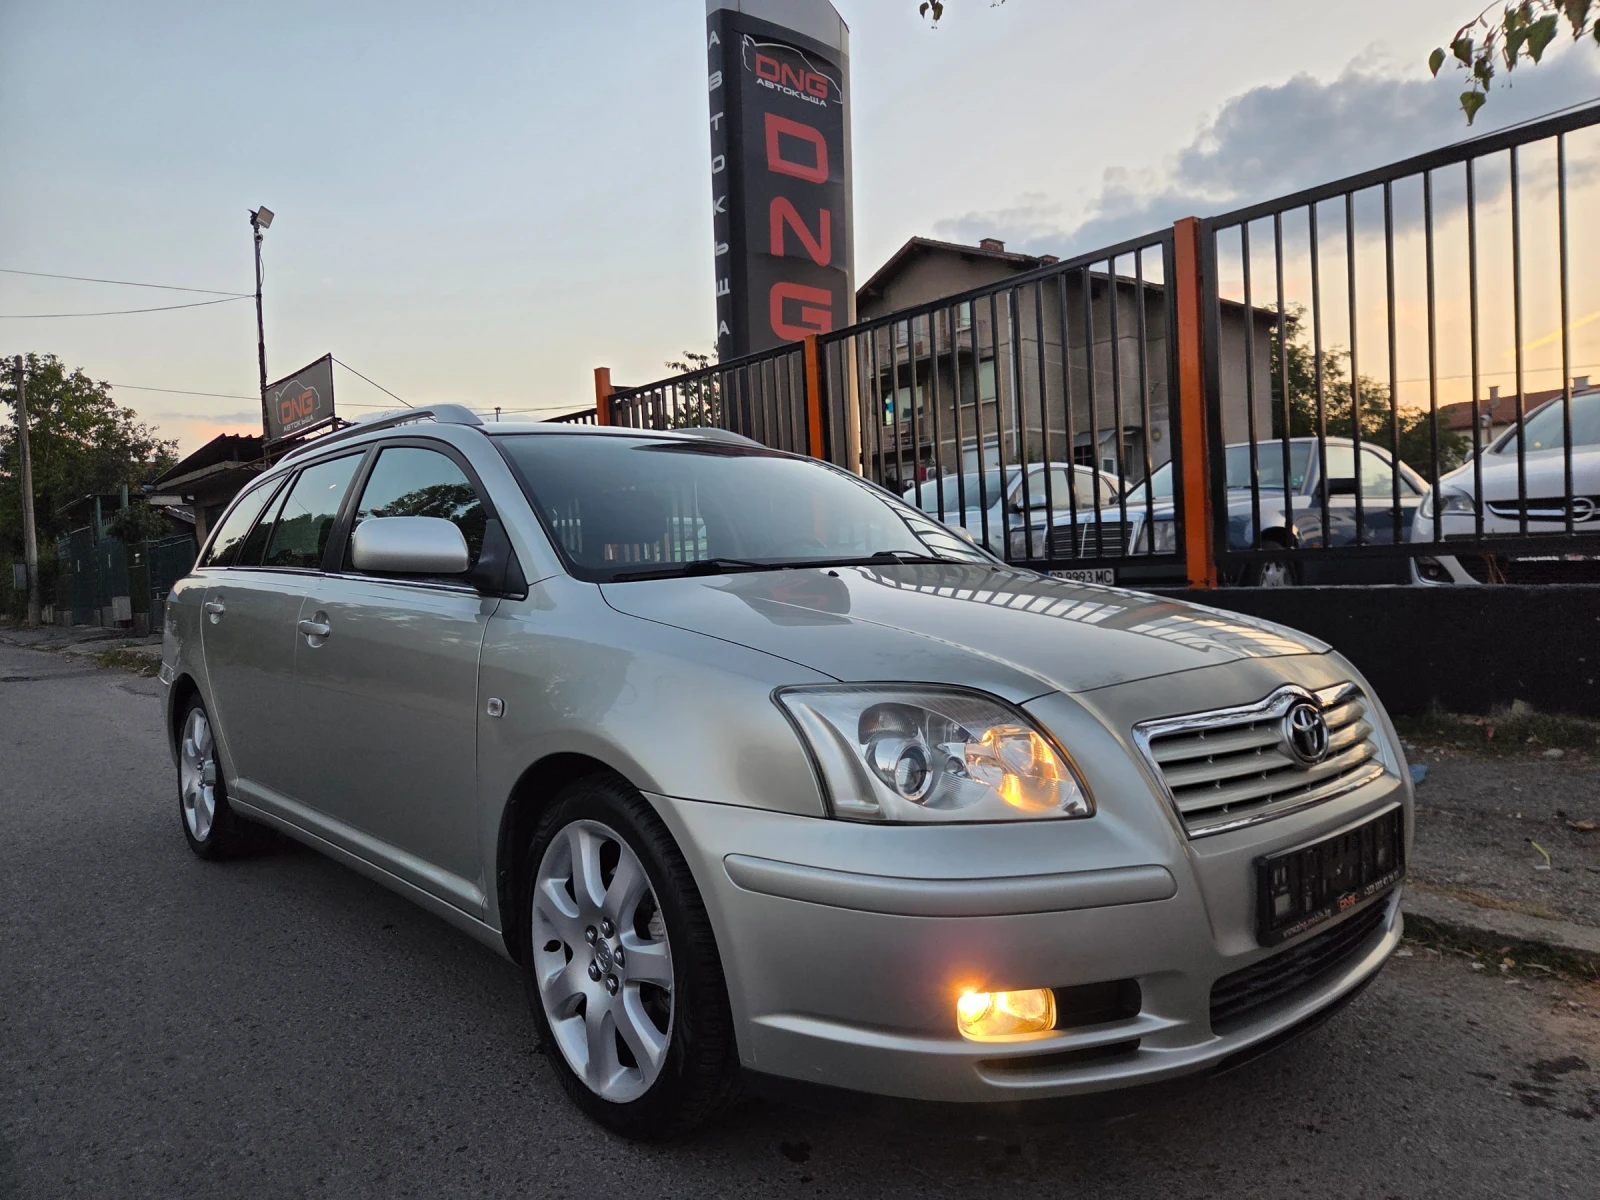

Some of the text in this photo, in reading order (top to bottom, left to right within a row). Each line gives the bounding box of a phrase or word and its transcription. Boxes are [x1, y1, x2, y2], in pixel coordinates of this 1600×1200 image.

[755, 53, 828, 99] DNG
[756, 78, 827, 107] АВТОКЪЩА
[764, 112, 832, 341] DNG
[281, 389, 313, 425] DNG
[1095, 570, 1112, 584] MC
